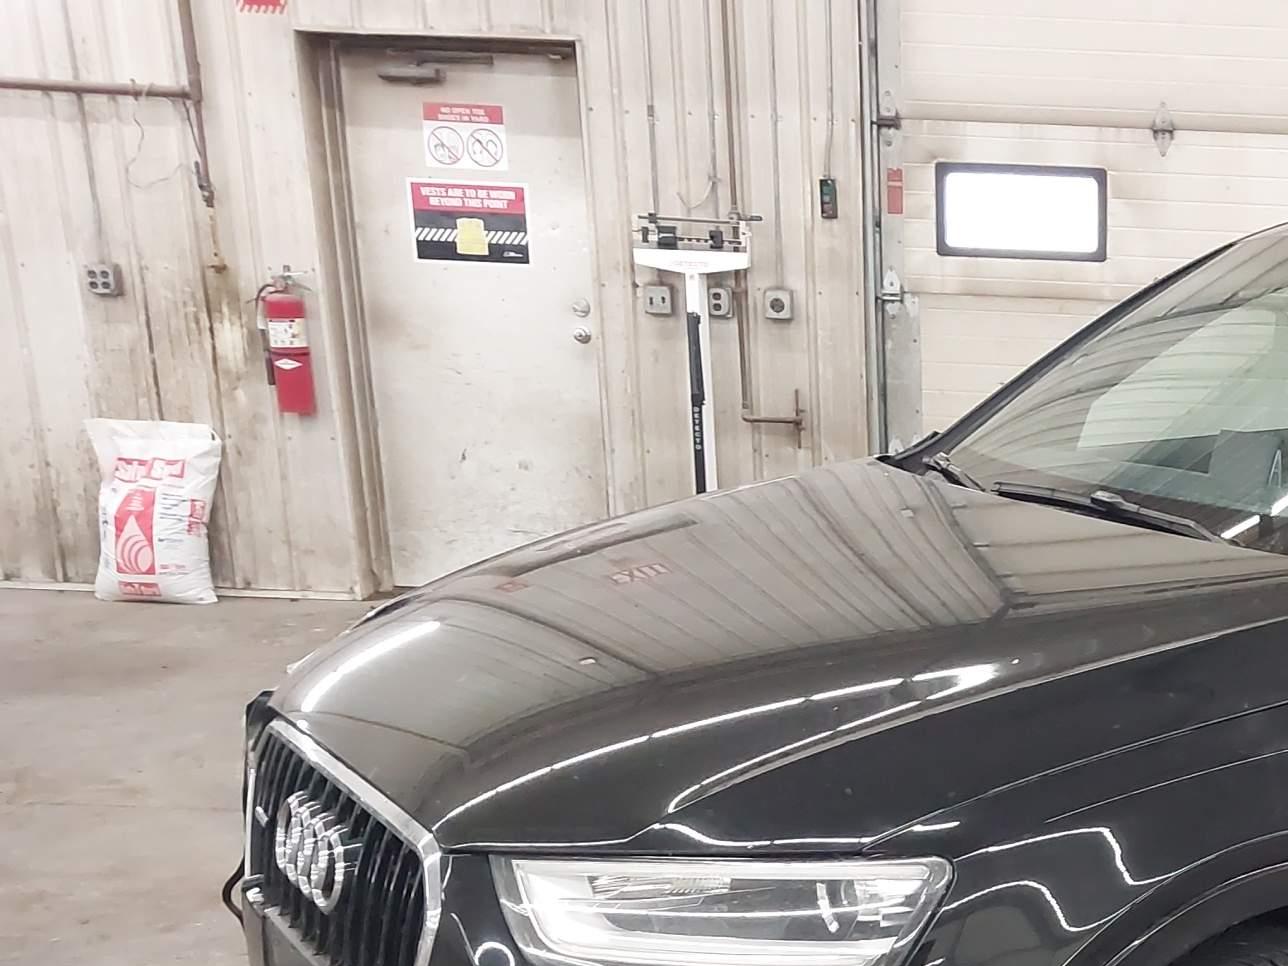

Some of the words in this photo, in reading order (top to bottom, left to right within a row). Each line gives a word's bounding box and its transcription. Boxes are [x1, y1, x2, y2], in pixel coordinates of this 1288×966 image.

[419, 186, 447, 196] VESTS
[447, 188, 464, 197] ARE
[464, 188, 476, 198] TO
[477, 189, 489, 199] BE
[489, 190, 516, 200] WORN
[428, 196, 463, 206] BEYOND
[463, 198, 482, 208] THIS
[483, 199, 508, 209] POINT
[693, 406, 702, 450] DETECTO
